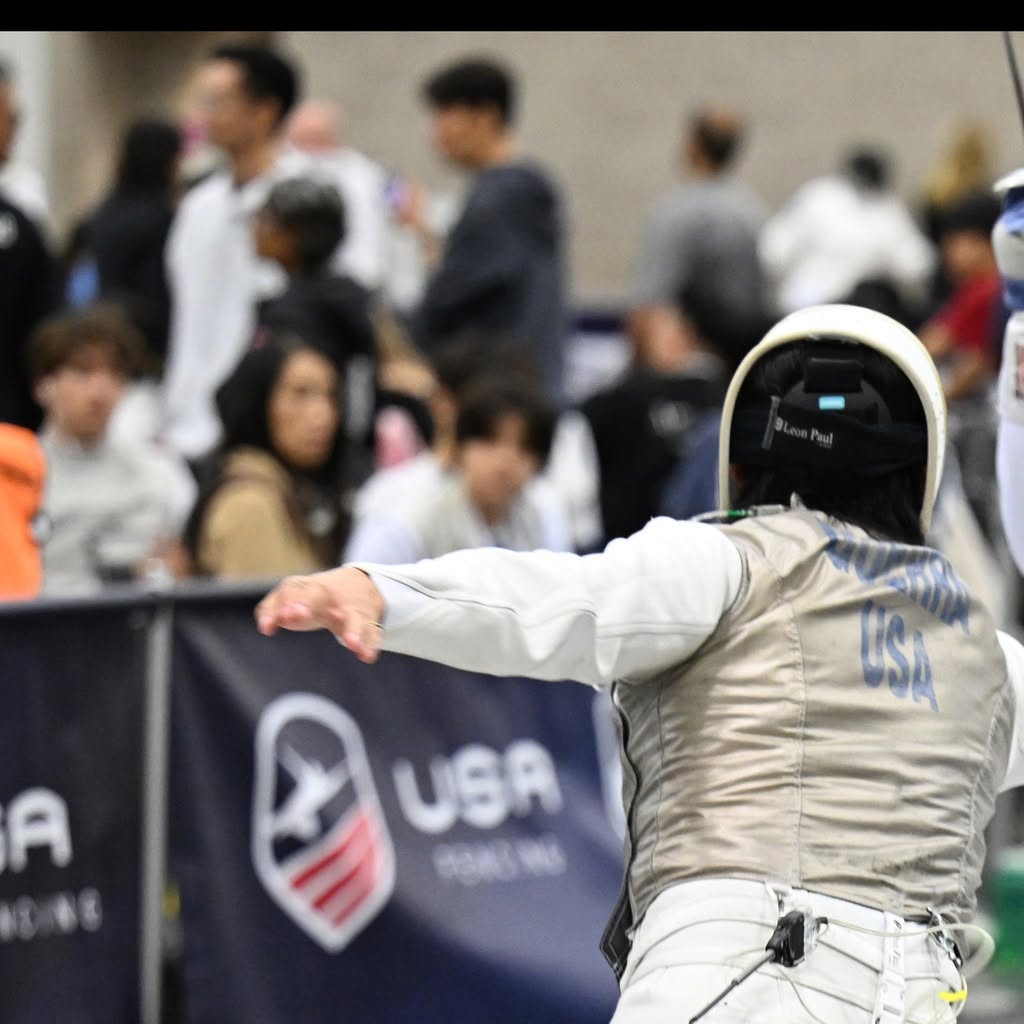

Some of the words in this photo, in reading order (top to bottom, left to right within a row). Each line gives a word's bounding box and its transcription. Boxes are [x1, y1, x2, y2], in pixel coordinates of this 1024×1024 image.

[783, 421, 808, 440] Leon
[810, 428, 834, 445] Paul
[861, 600, 939, 713] USA
[392, 738, 564, 835] USA
